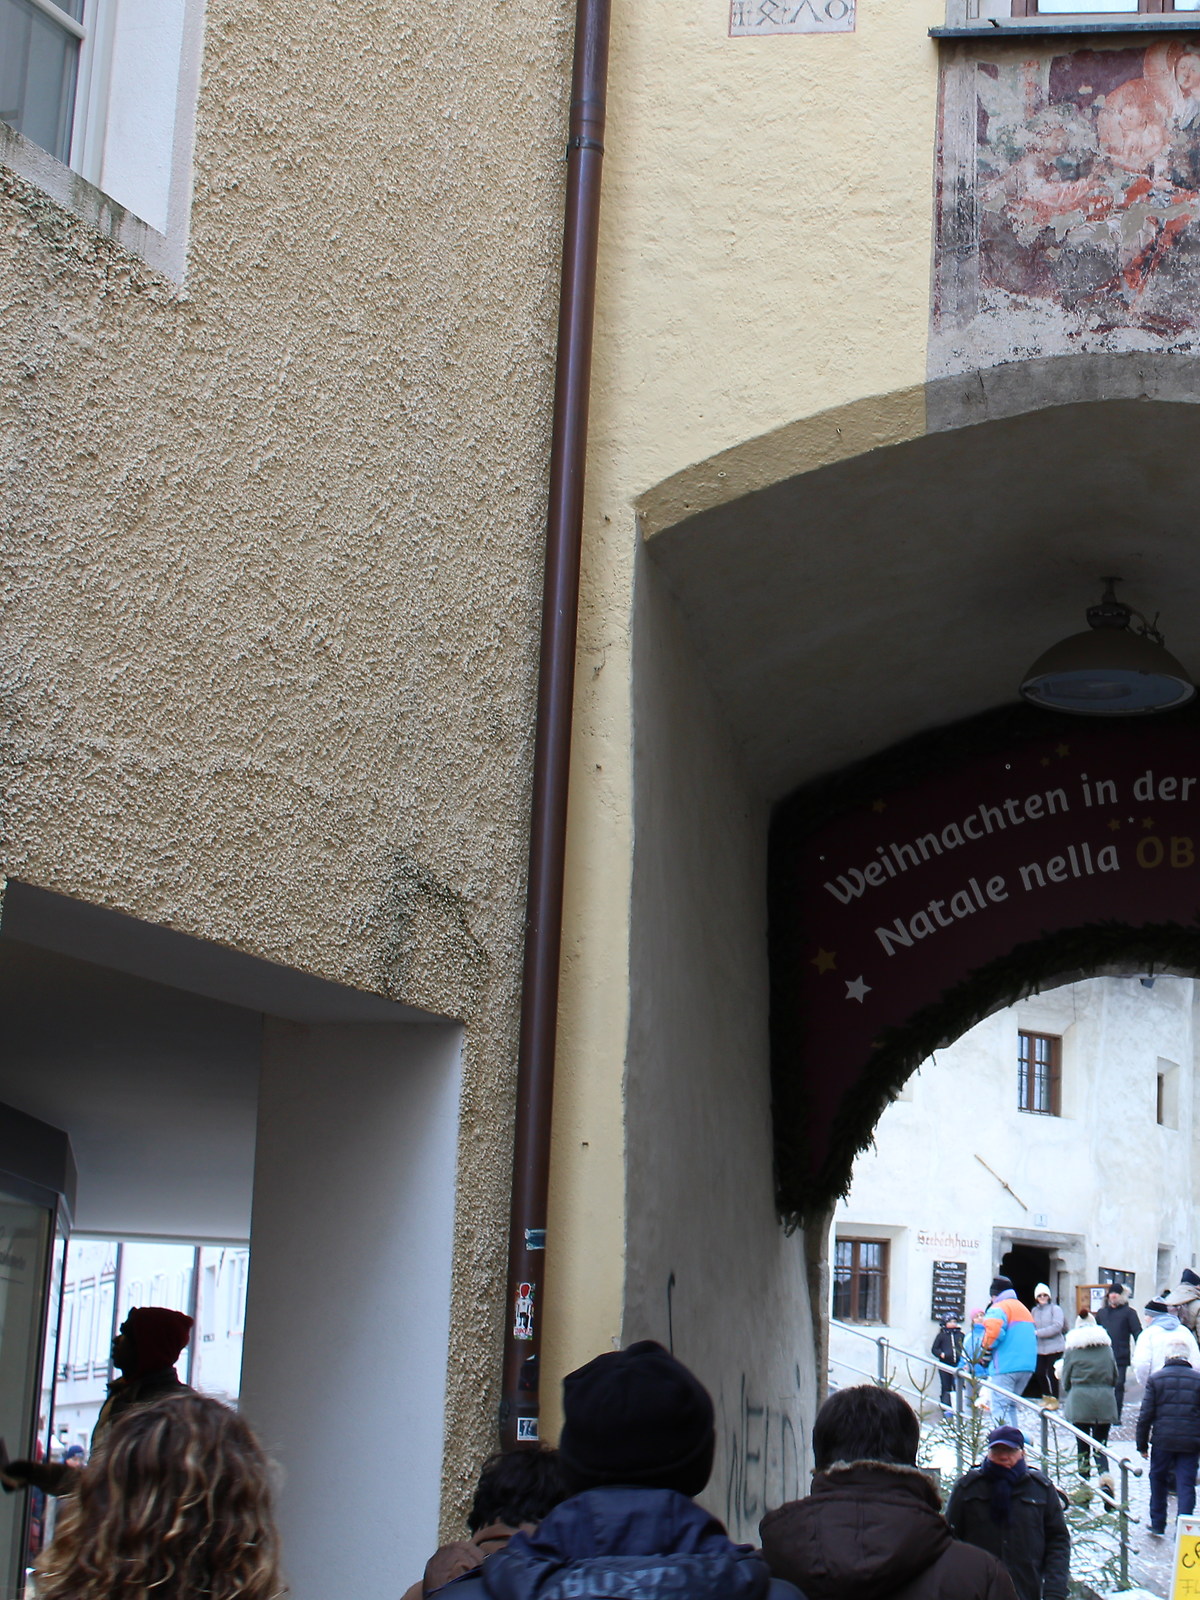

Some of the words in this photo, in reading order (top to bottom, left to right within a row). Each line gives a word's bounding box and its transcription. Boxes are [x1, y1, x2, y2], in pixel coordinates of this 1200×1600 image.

[823, 787, 1069, 904] Weihnachten
[1081, 772, 1118, 808] in
[1133, 770, 1197, 801] der
[874, 875, 1009, 957] Natale
[1018, 842, 1121, 891] nella
